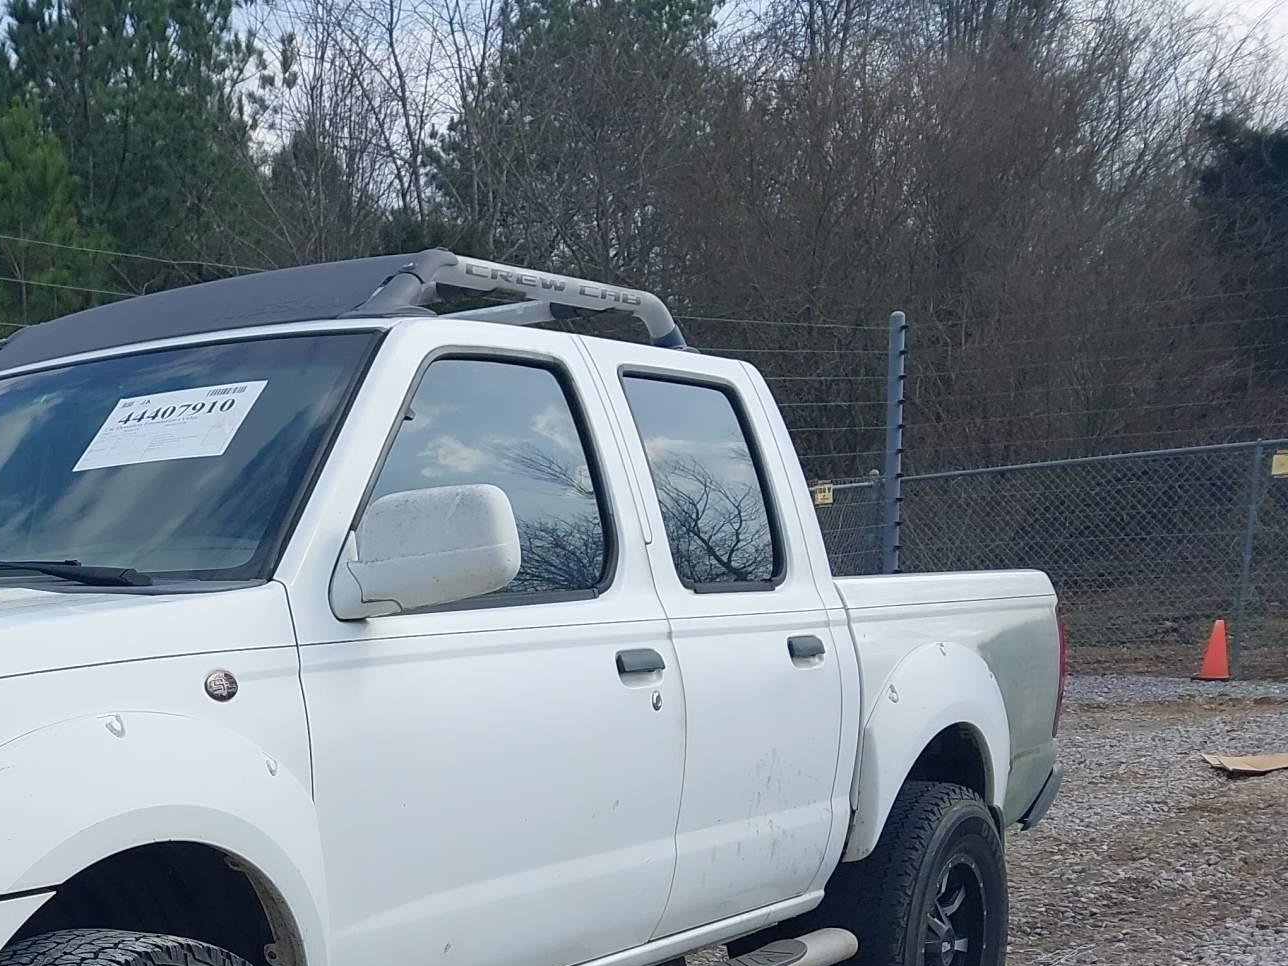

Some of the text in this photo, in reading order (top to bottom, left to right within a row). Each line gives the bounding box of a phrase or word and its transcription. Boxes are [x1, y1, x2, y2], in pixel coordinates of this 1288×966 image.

[465, 262, 642, 306] CREW CAB
[117, 398, 236, 425] 44407910
